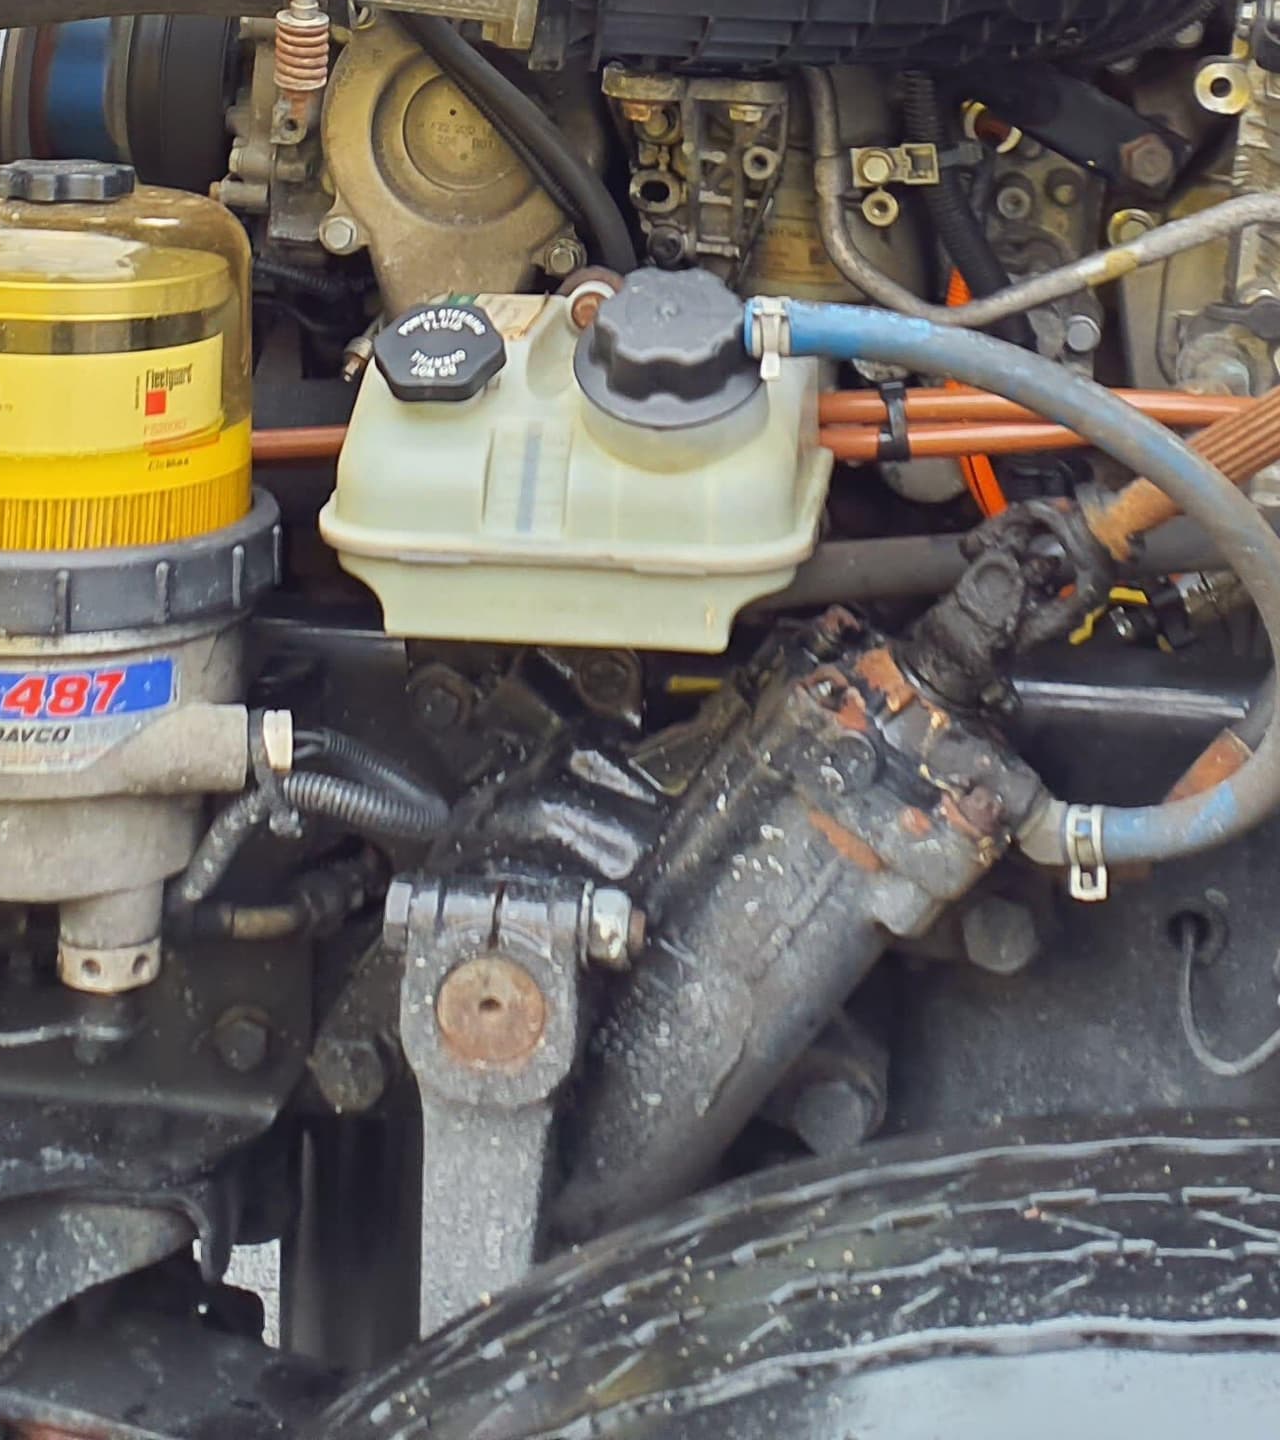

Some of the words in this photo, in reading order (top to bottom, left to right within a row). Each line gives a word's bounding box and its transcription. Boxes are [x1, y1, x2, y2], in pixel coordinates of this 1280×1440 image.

[398, 310, 434, 336] POWER
[438, 309, 486, 336] STEERING
[423, 319, 463, 332] FLUID
[146, 363, 193, 393] Fleetguard
[0, 671, 127, 717] 487
